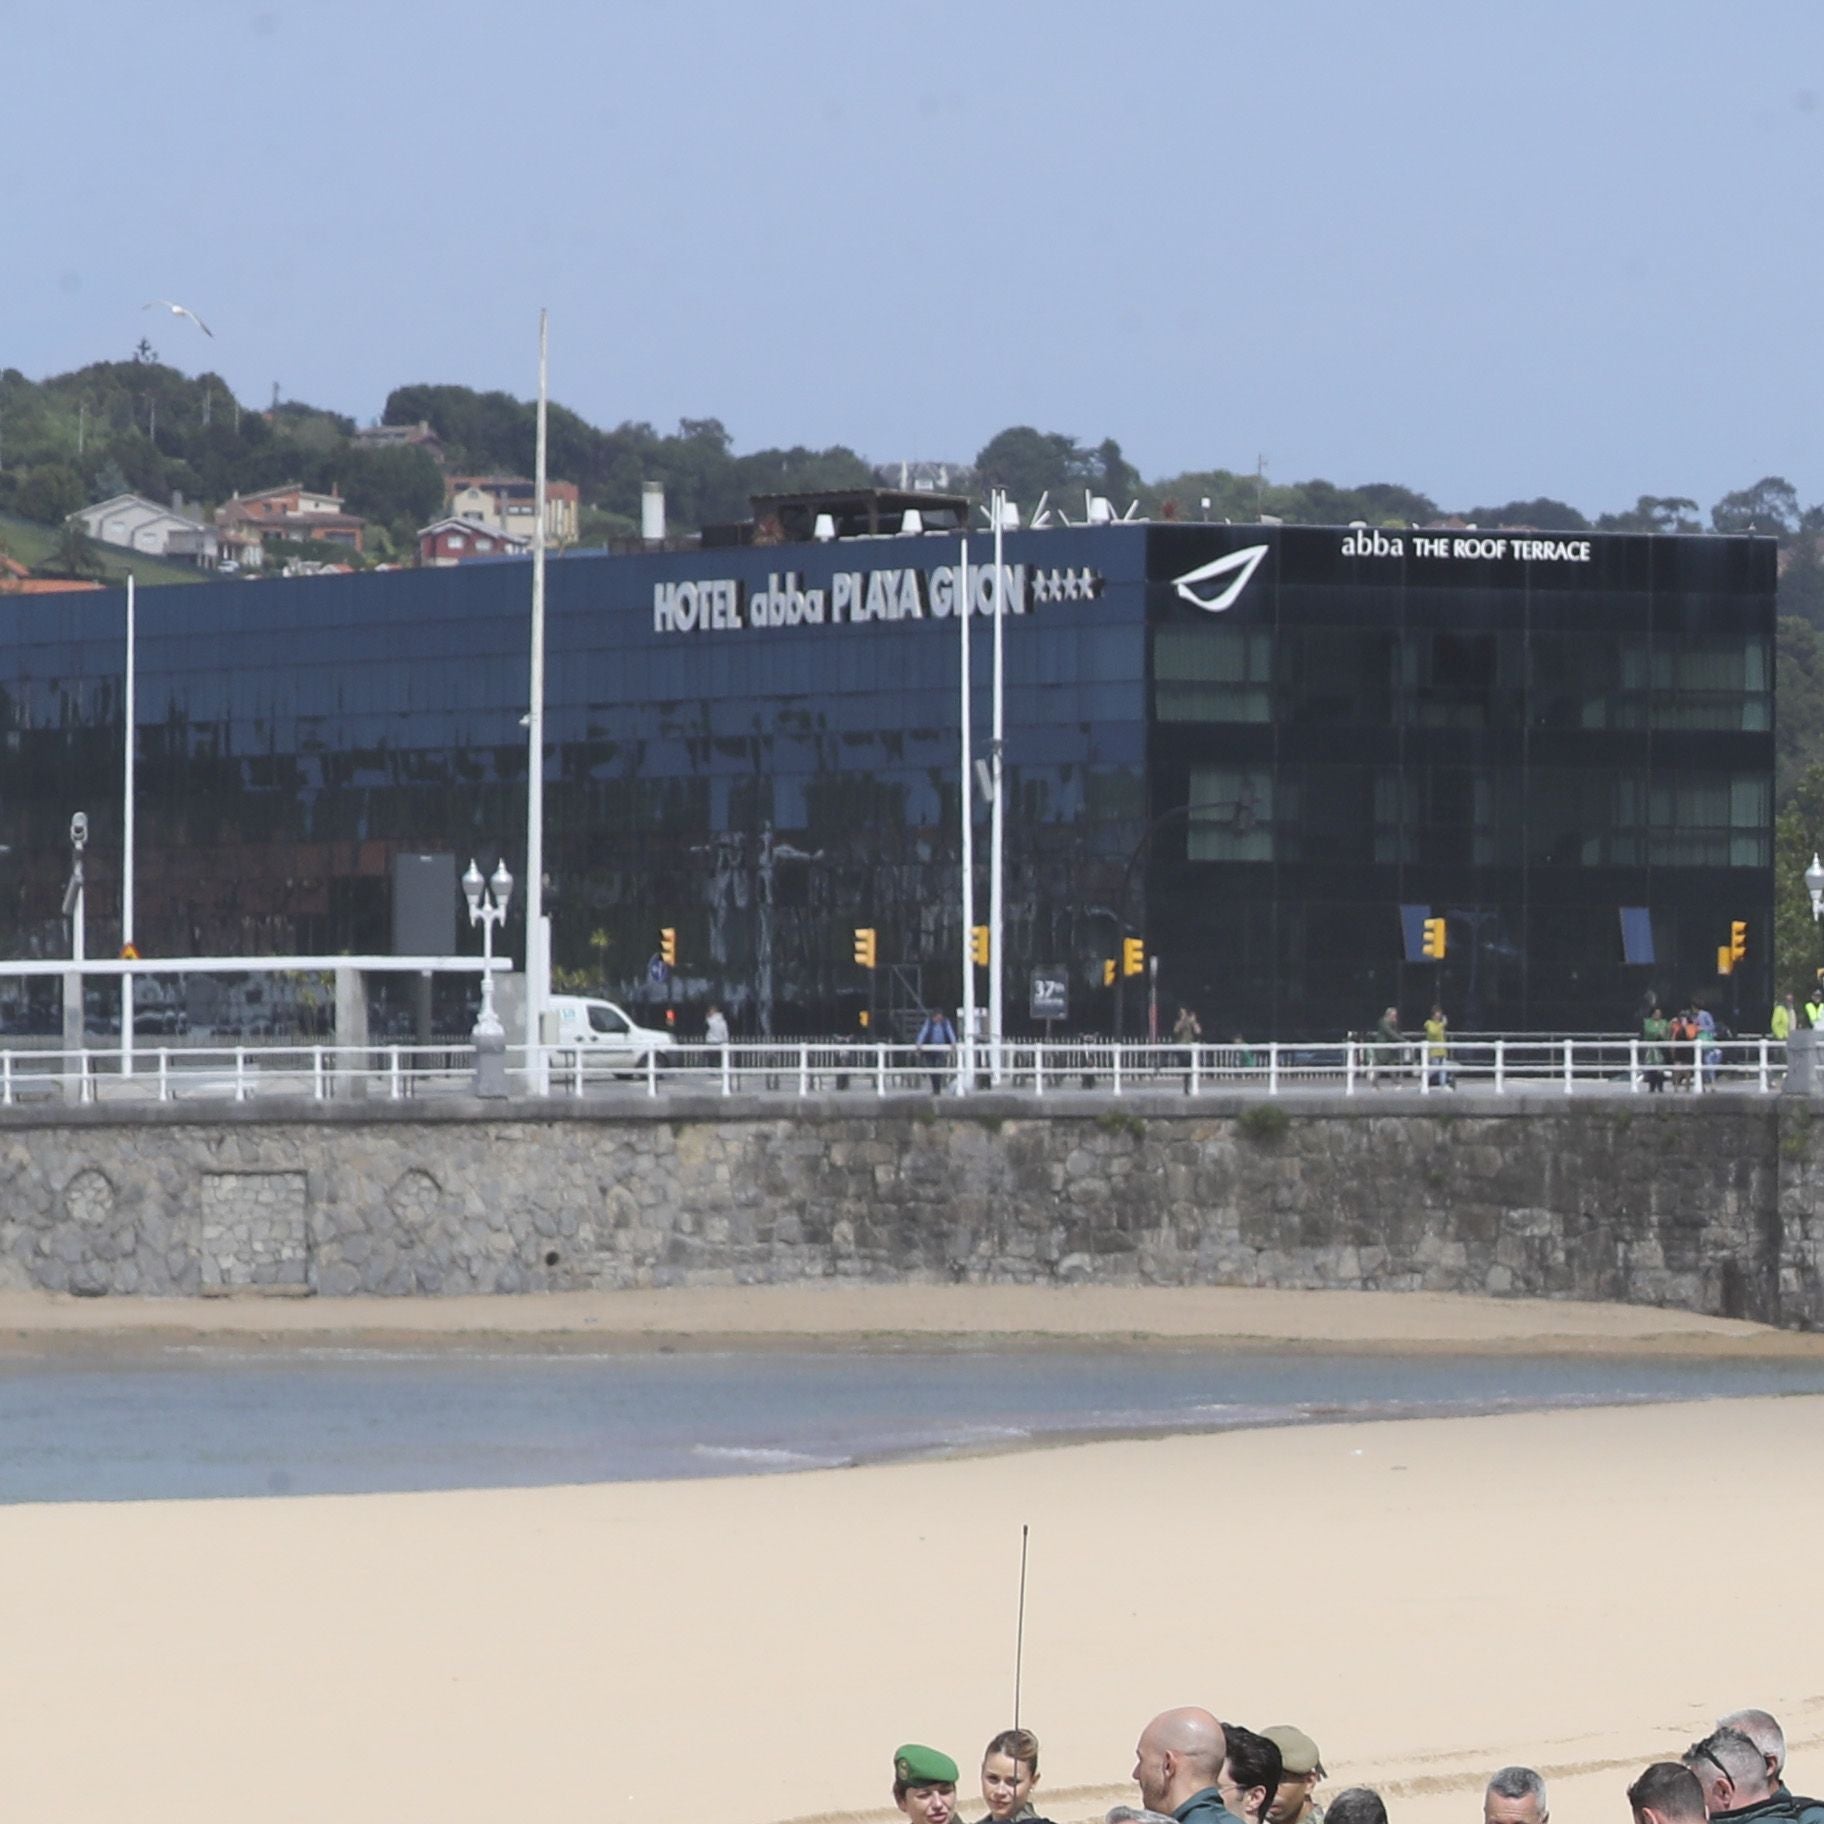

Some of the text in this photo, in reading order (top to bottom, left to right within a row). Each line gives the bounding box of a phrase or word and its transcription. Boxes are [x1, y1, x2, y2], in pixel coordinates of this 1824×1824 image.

[1341, 529, 1591, 561] abba THE ROOF TERRACE
[654, 579, 742, 632] HOTEL
[751, 571, 824, 627] abba
[832, 569, 923, 624] PLAYA
